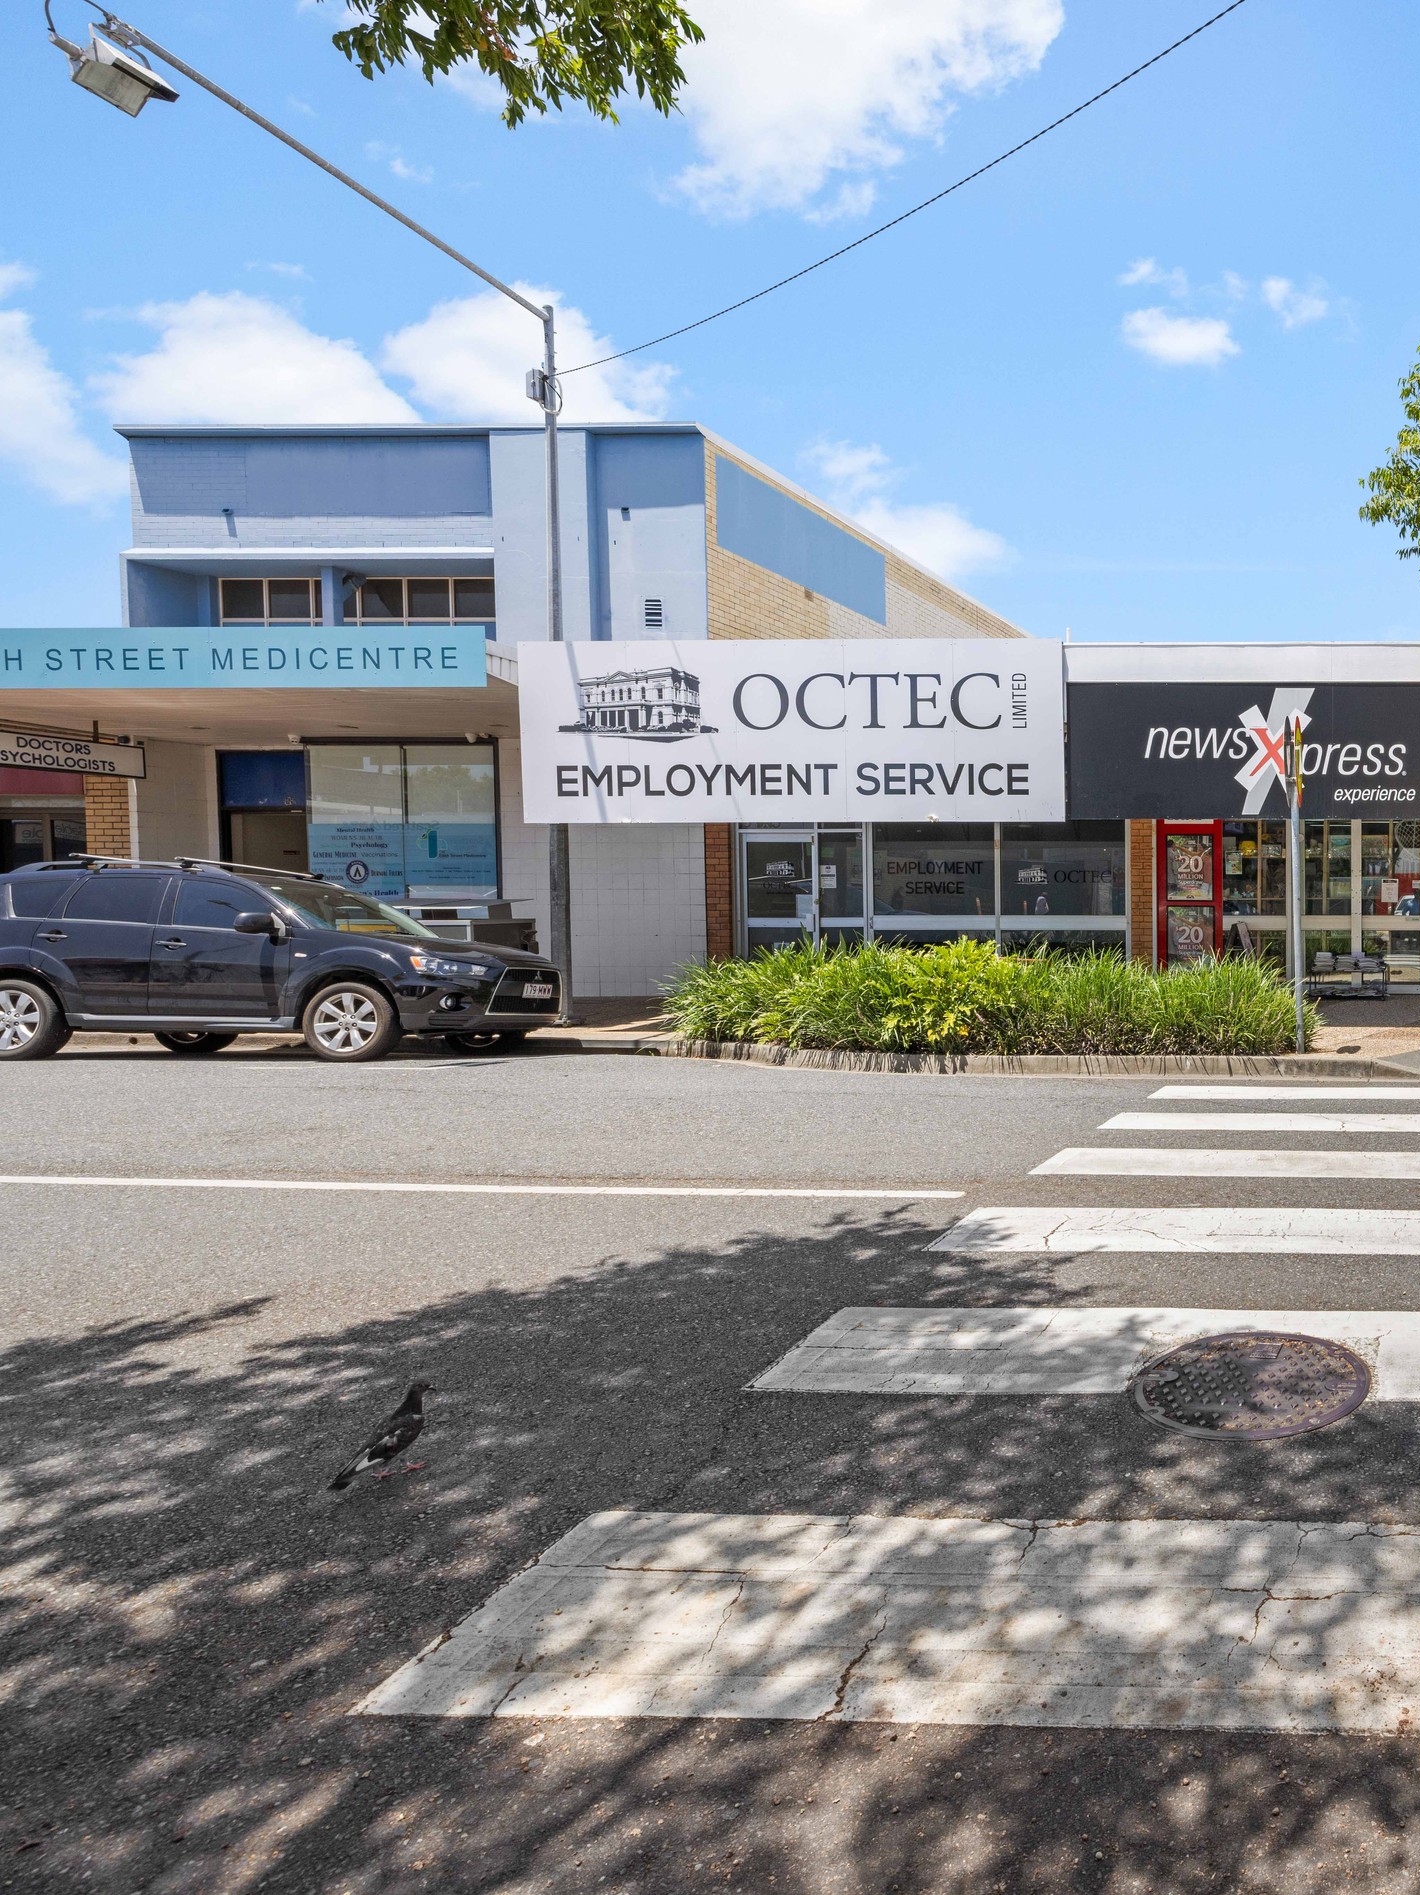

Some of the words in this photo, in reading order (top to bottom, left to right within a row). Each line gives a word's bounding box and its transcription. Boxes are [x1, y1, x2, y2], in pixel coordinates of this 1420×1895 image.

[45, 647, 190, 671] STREET
[210, 646, 459, 670] MEDICENTRE
[732, 671, 1003, 730] OCTEC
[1011, 673, 1027, 729] LIMITED
[16, 736, 91, 756] DOCTORS
[0, 750, 116, 772] SYCHOLOGISTS
[556, 763, 838, 797] EMPLOYMENT
[855, 762, 1030, 796] SERVICE
[1333, 785, 1416, 804] experience
[887, 861, 984, 875] EMPLOYMENT
[1054, 869, 1113, 884] OCTEC
[905, 881, 966, 895] SERVICE
